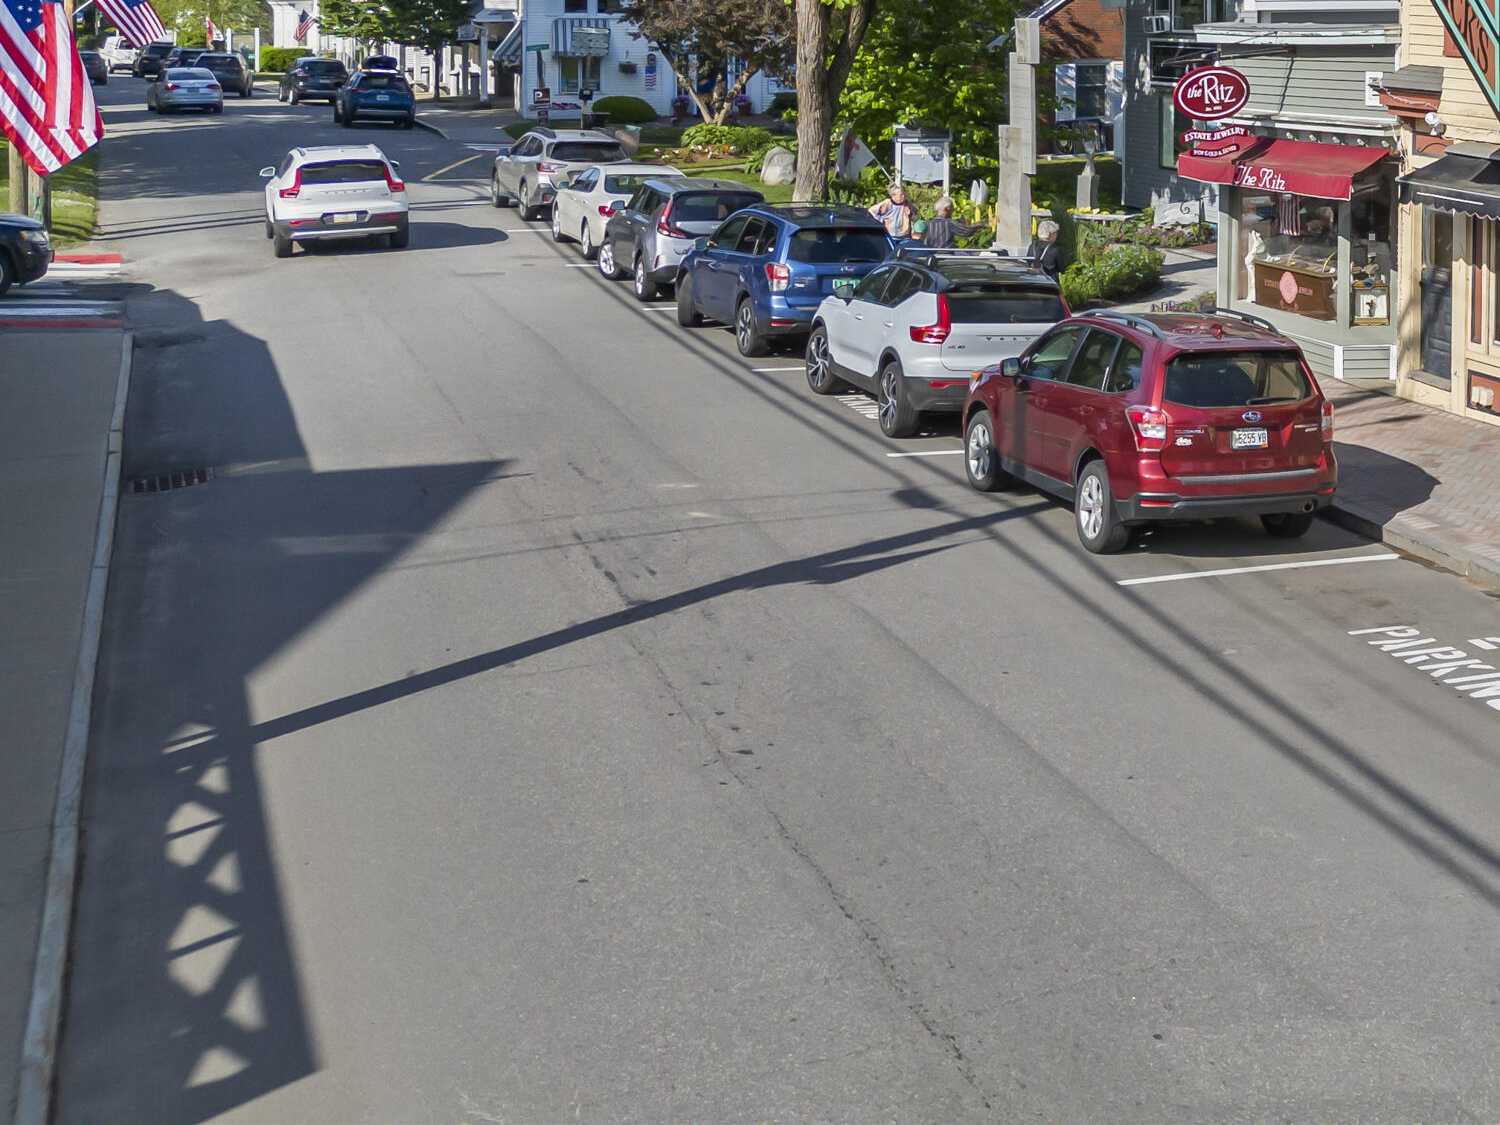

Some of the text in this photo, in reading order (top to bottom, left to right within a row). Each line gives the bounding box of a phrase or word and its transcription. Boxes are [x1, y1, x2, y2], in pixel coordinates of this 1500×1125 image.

[1187, 75, 1236, 104] the Ritz
[1184, 127, 1245, 142] ESTATE JEWELRY
[1234, 165, 1286, 190] The Ritz
